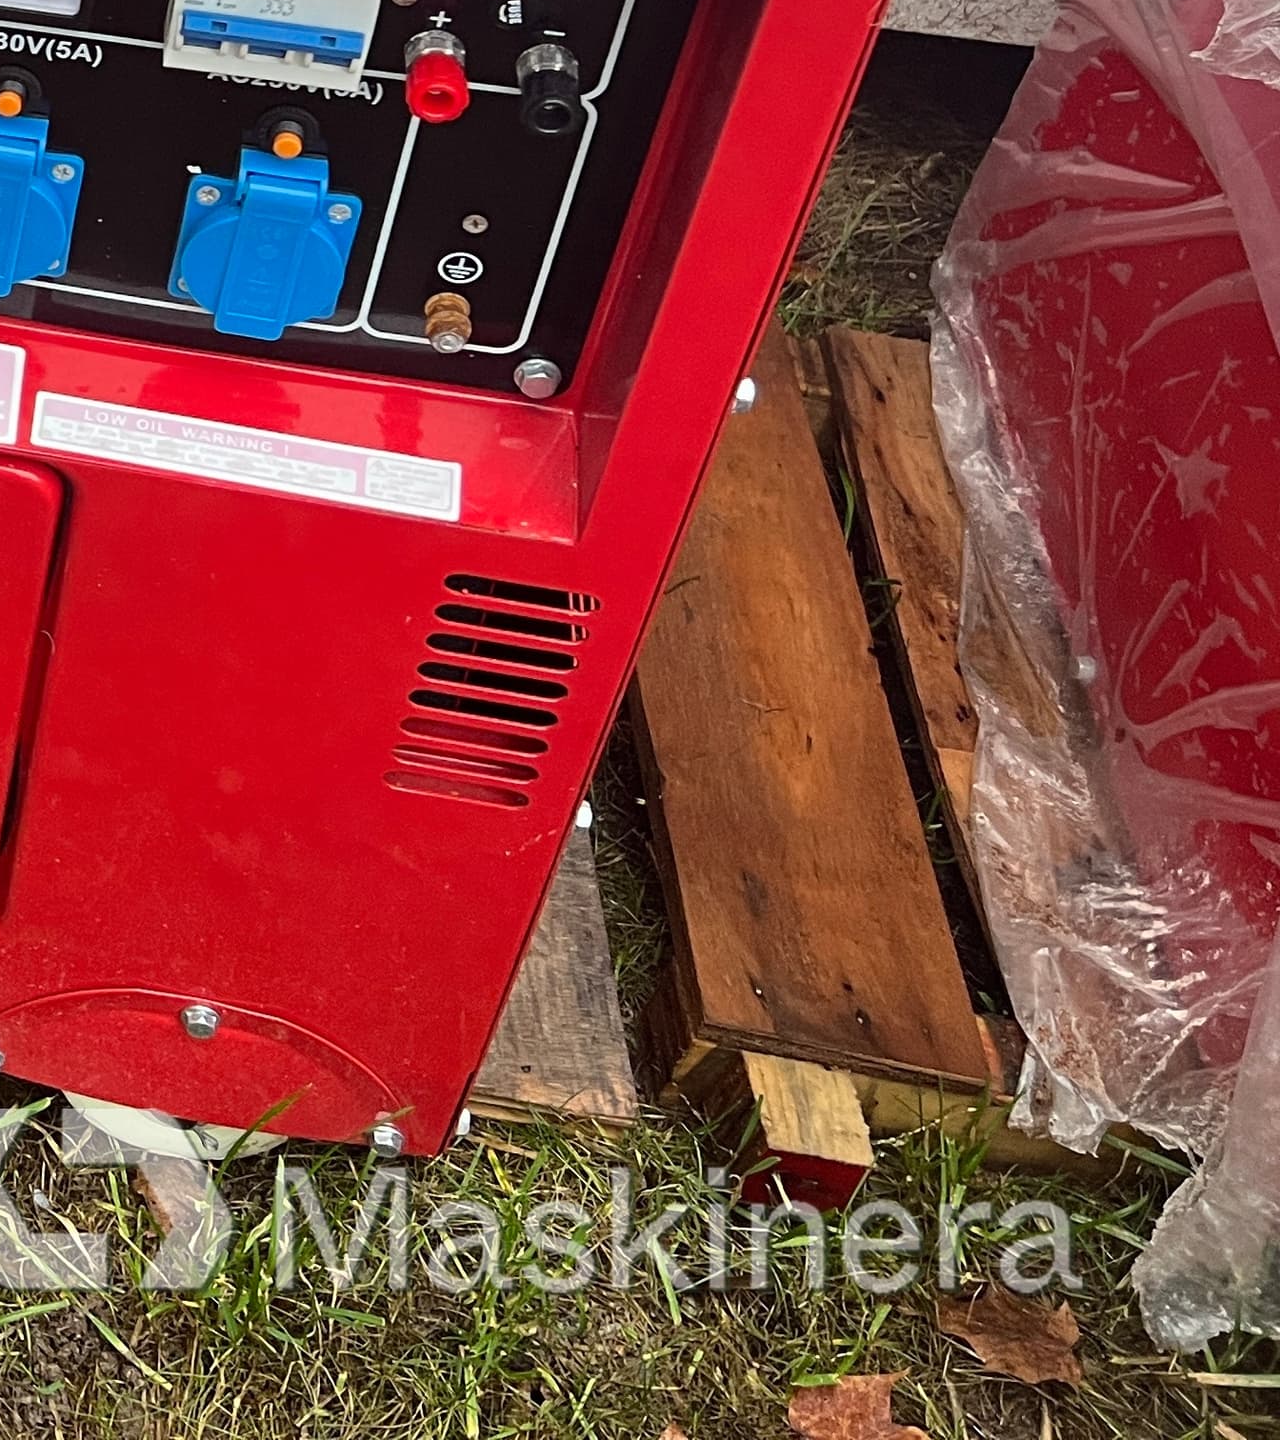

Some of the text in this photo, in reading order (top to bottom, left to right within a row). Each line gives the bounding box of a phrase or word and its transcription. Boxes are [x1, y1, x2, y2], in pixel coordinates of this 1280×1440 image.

[507, 0, 523, 25] FUSE
[83, 409, 127, 428] LOW
[135, 418, 166, 435] OIL
[181, 426, 274, 454] WARNING
